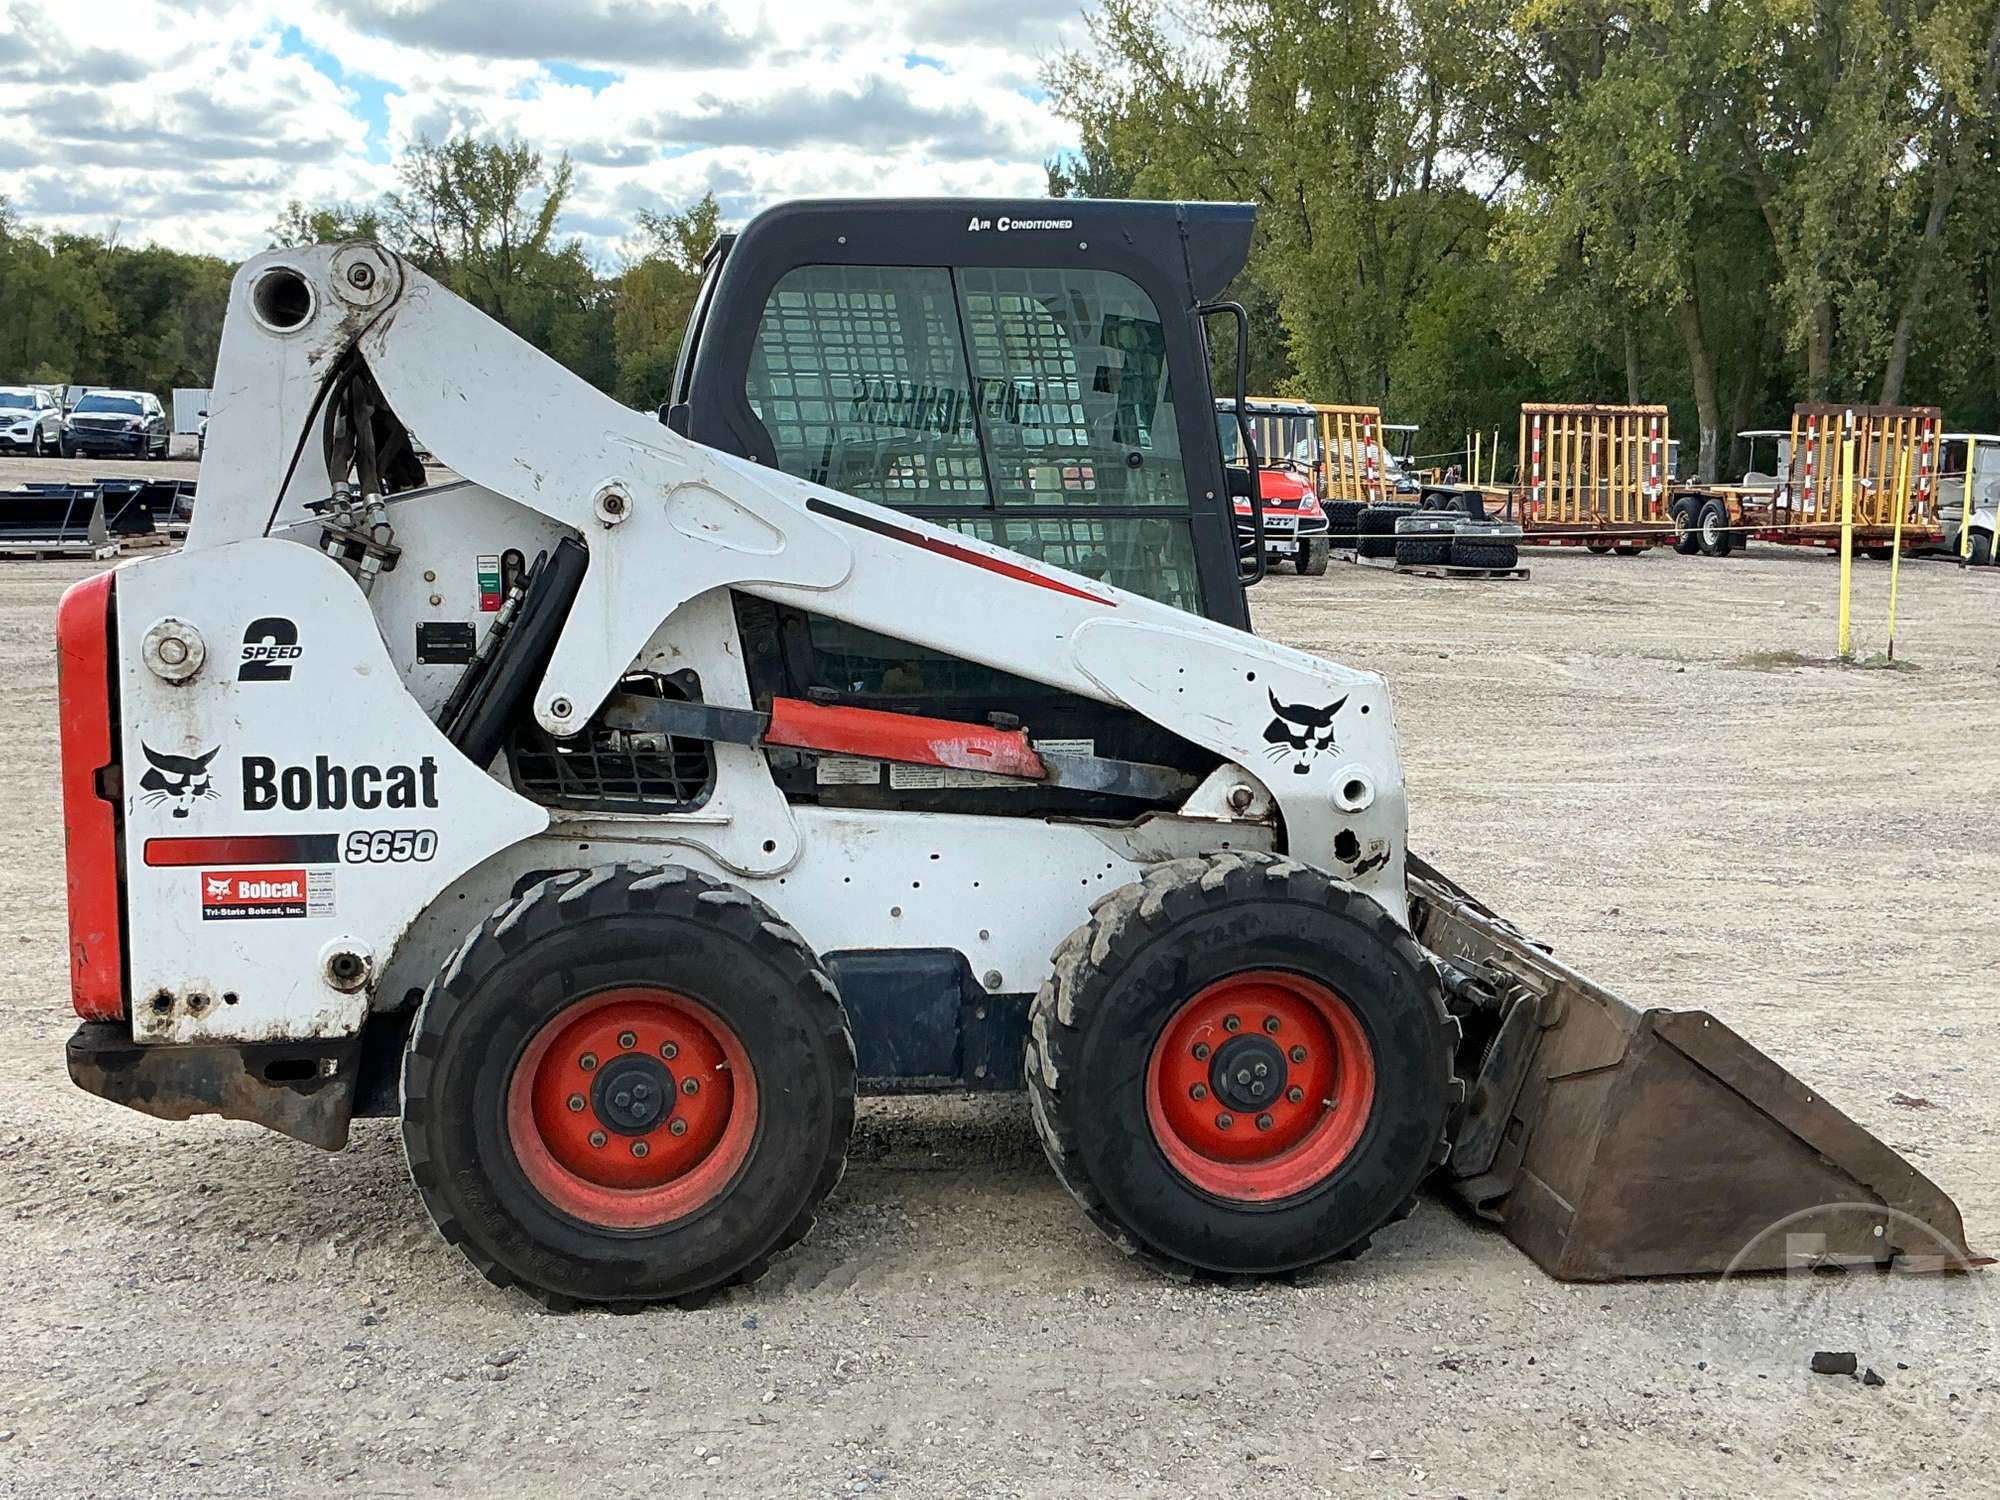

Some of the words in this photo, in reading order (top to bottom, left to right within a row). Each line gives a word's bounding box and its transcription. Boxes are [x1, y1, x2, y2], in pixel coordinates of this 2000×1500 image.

[237, 616, 299, 682] 2
[240, 646, 303, 660] SPEED
[242, 755, 439, 812] Bobcat
[345, 829, 439, 864] S650
[205, 908, 246, 916] Tri-State
[248, 907, 284, 916] Bobcat,
[286, 907, 304, 915] Inc.
